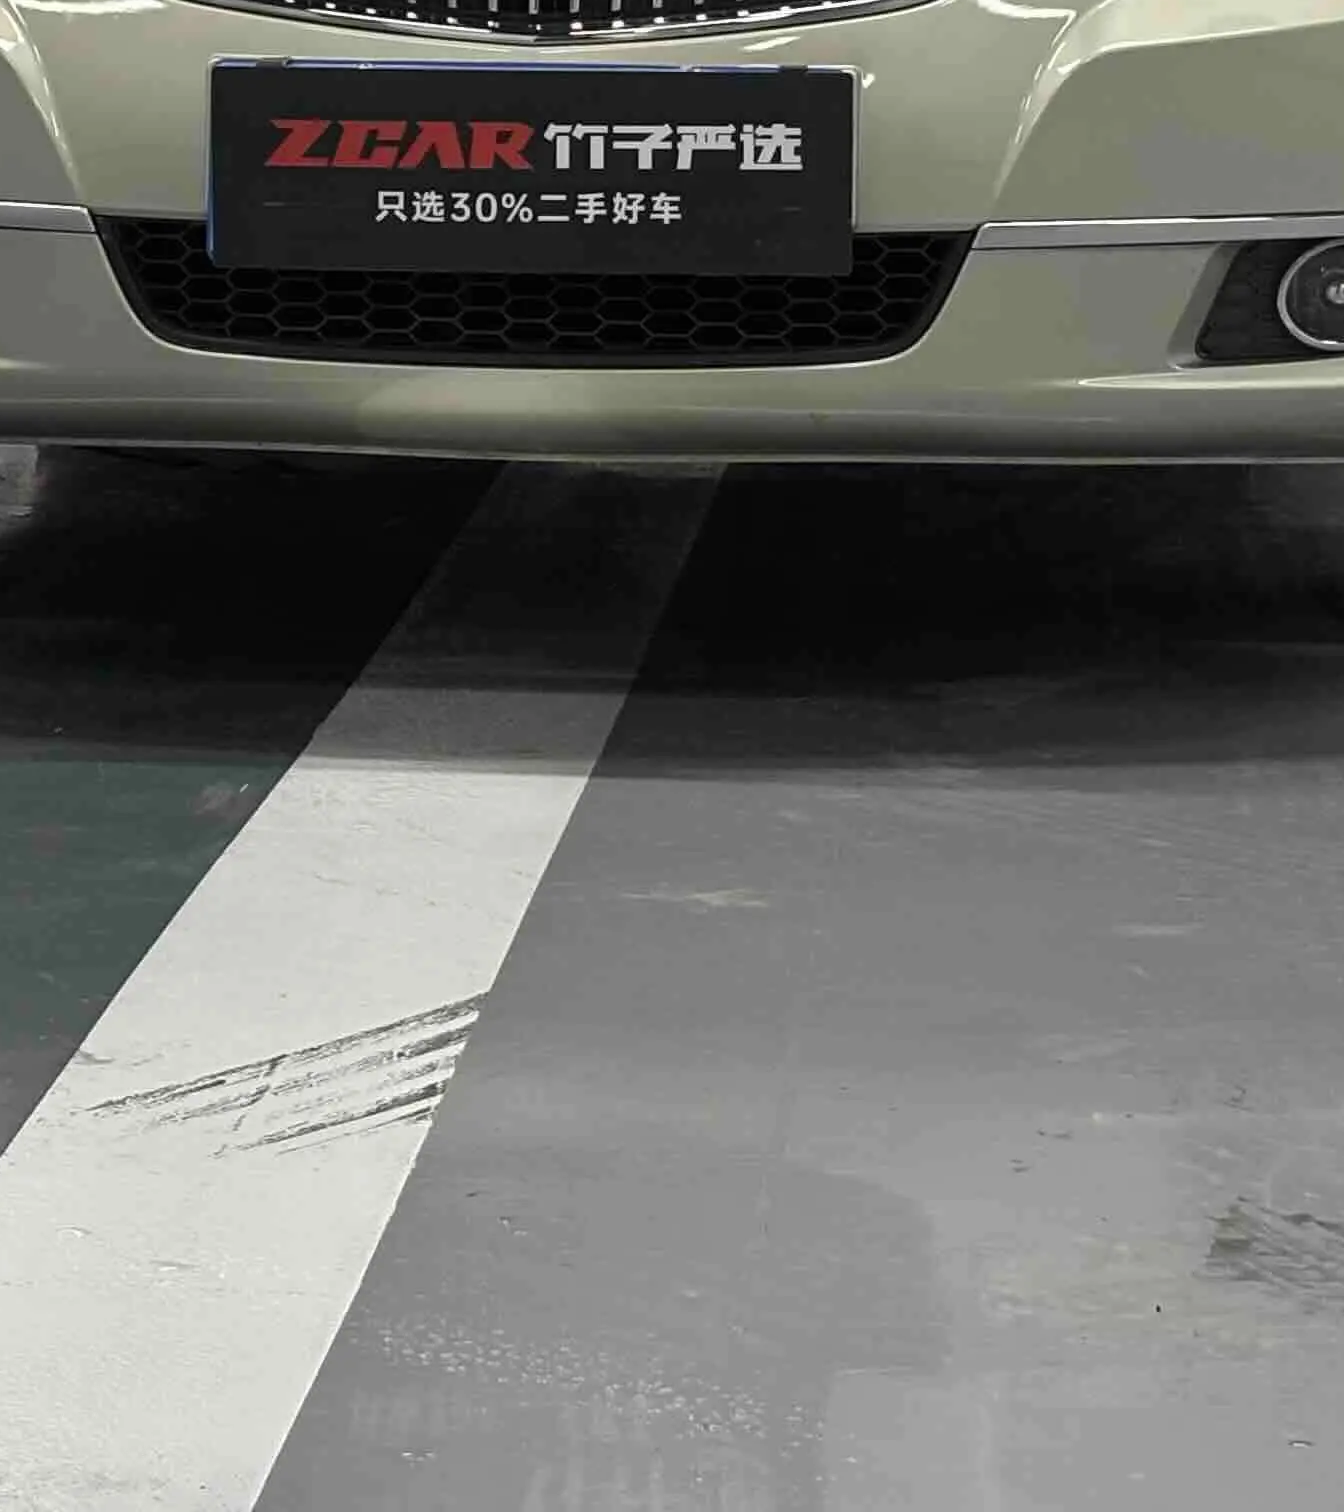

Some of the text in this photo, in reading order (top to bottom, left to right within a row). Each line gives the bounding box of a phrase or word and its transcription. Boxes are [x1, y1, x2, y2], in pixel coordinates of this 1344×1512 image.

[264, 119, 804, 171] ZCAR 竹子严选
[374, 190, 683, 225] 只选30%二手好车
